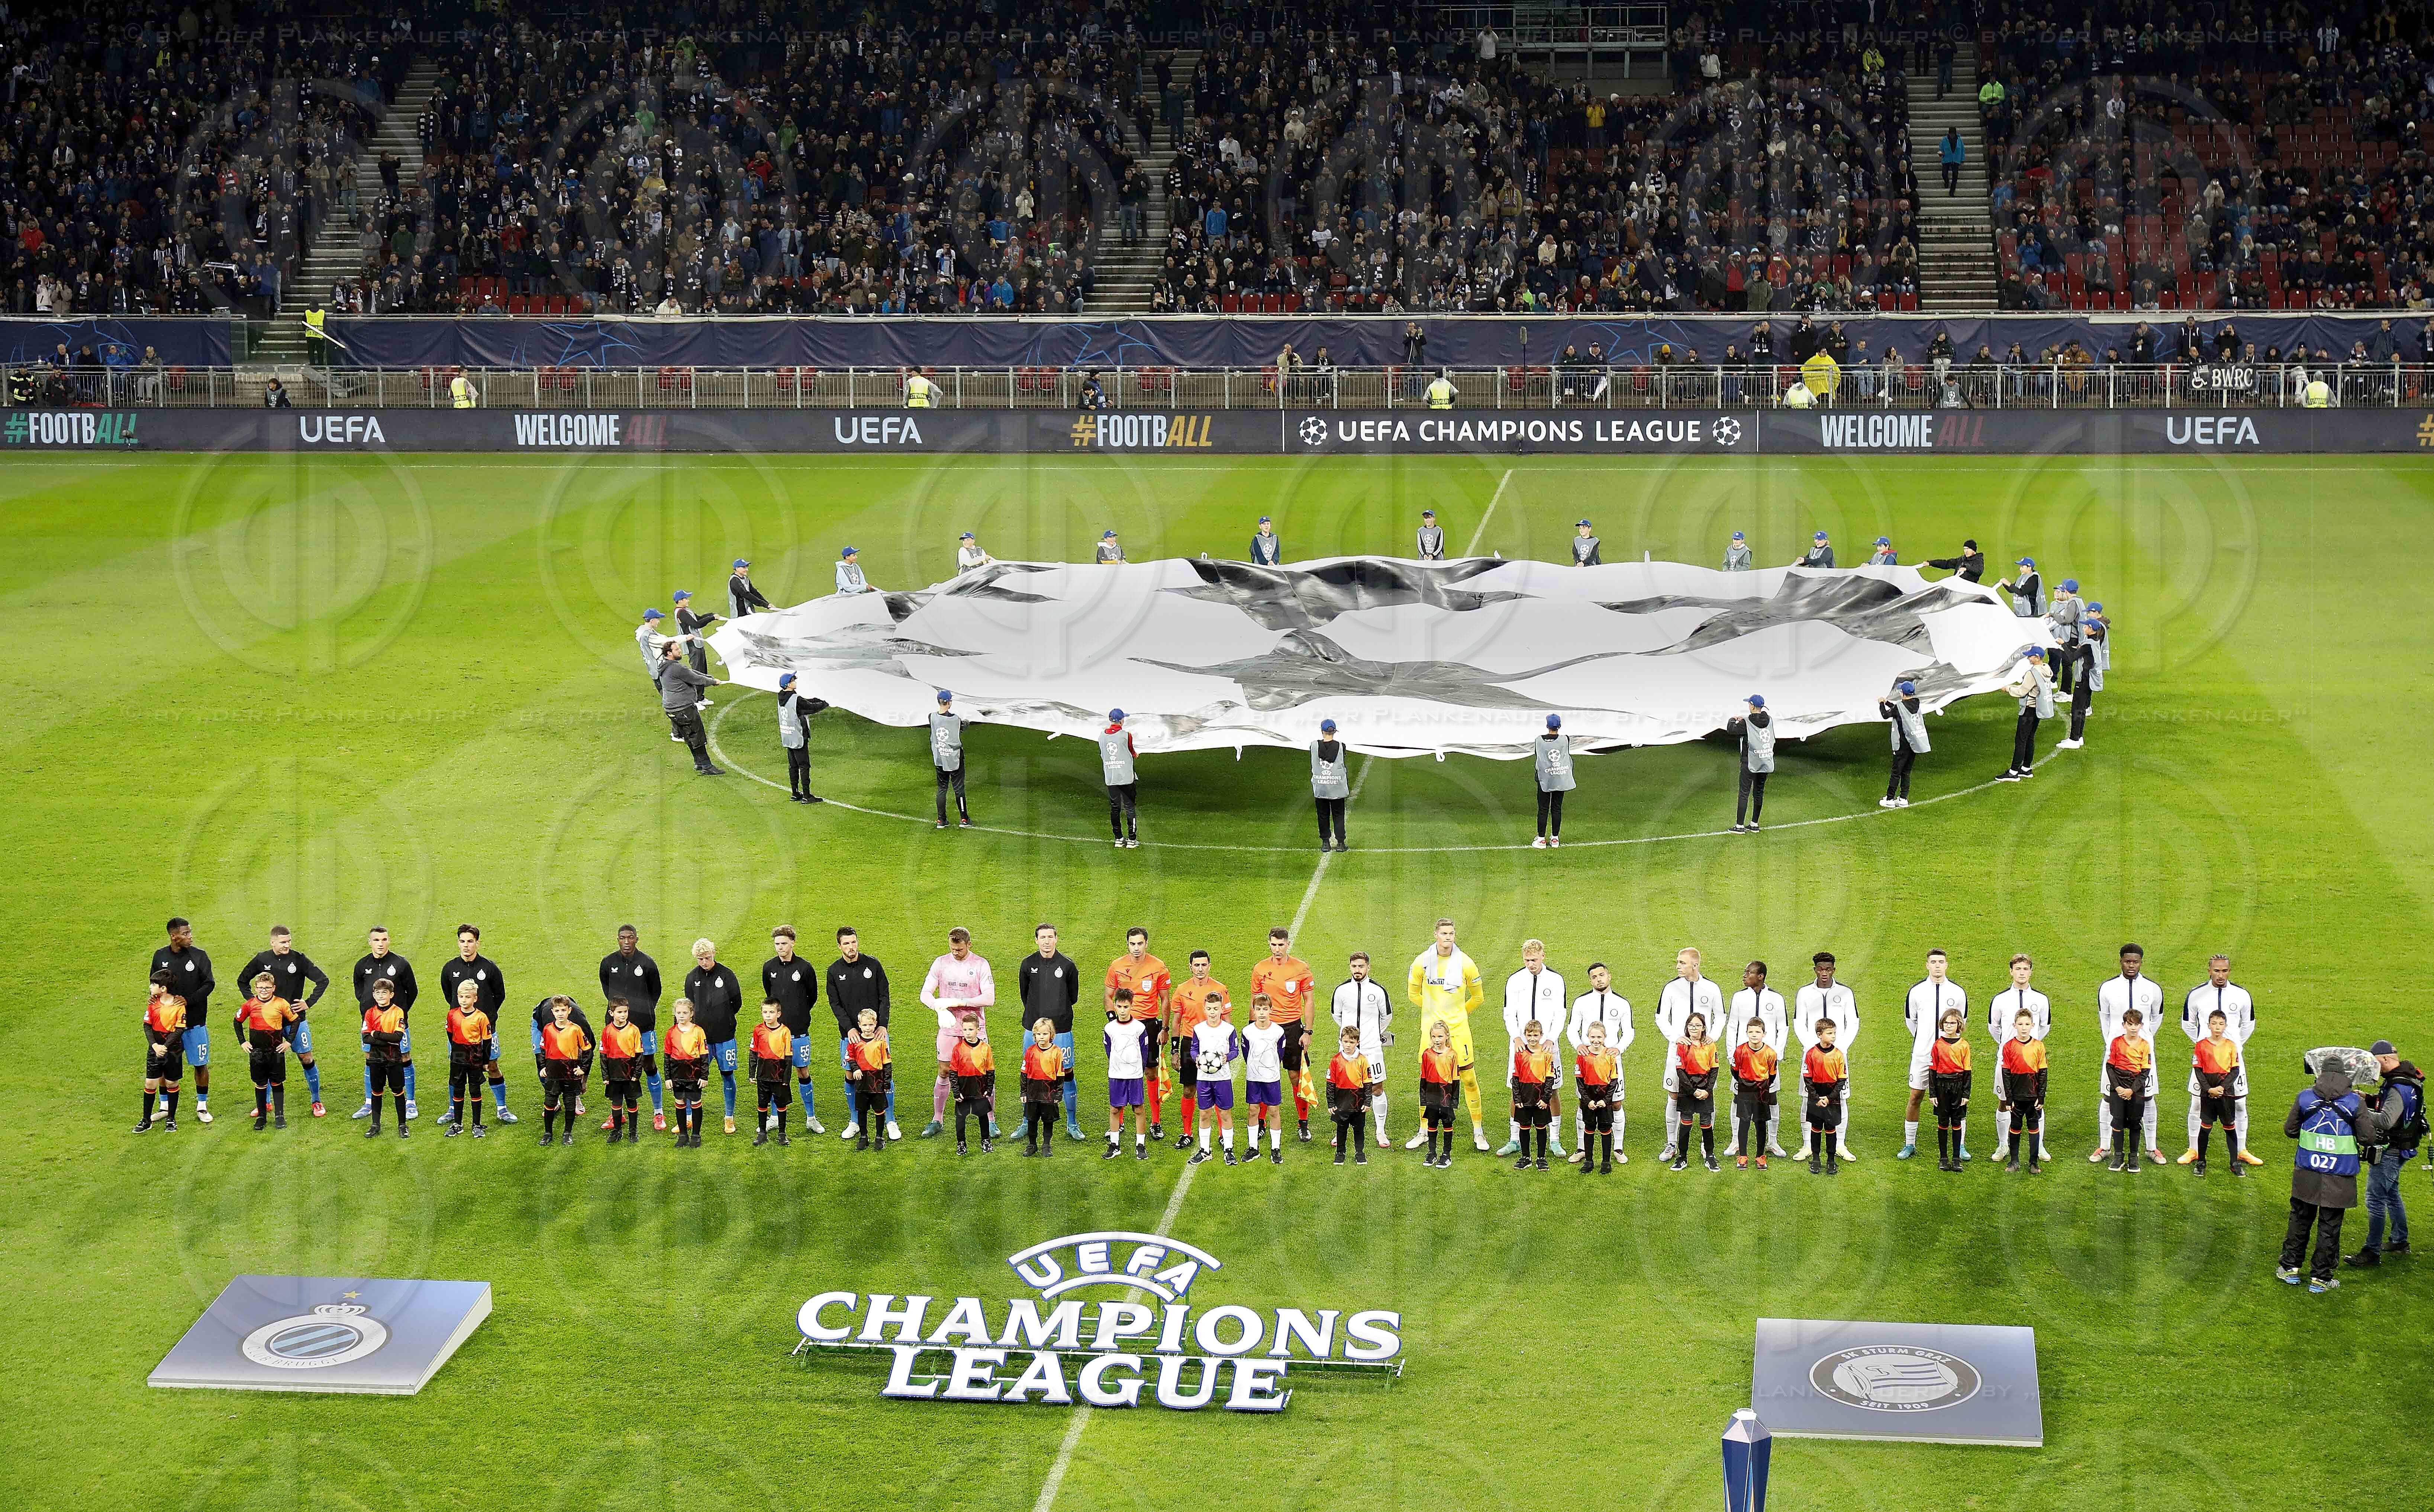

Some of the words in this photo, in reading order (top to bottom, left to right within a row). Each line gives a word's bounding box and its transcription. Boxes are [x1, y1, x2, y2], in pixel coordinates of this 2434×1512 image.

[2212, 366, 2253, 389] BWRC
[4, 413, 138, 444] #FOOTBALL
[300, 416, 385, 443] UEFA
[515, 414, 620, 445] WELCOME
[625, 415, 668, 445] ALL
[835, 417, 922, 444] UEFA
[1070, 415, 1212, 447] #FOOTBALL
[1339, 420, 1410, 442] UEFA
[1419, 420, 1583, 442] CHAMPIONS
[1596, 420, 1701, 442] LEAGUE
[1821, 415, 1932, 447] WELCOME
[1937, 415, 1984, 447] ALL
[2167, 417, 2260, 444] UEFA
[301, 1032, 307, 1043] 8
[197, 1044, 207, 1056] 15
[725, 1049, 735, 1061] 65
[800, 1045, 809, 1057] 55
[1061, 1046, 1071, 1058] 20
[1371, 1063, 1382, 1075] 10
[1615, 1080, 1624, 1093] 22
[2144, 1075, 2153, 1088] 21
[2237, 1074, 2245, 1086] 47
[2316, 1136, 2335, 1150] HB
[2310, 1154, 2337, 1170] 027
[1015, 1241, 1199, 1297] UEFA
[796, 1292, 1402, 1361] CHAMPIONS
[1840, 1351, 1858, 1360] SK
[1915, 1350, 1951, 1364] GRAZ
[880, 1346, 1290, 1412] LEAGUE
[1860, 1400, 1890, 1409] SEIT
